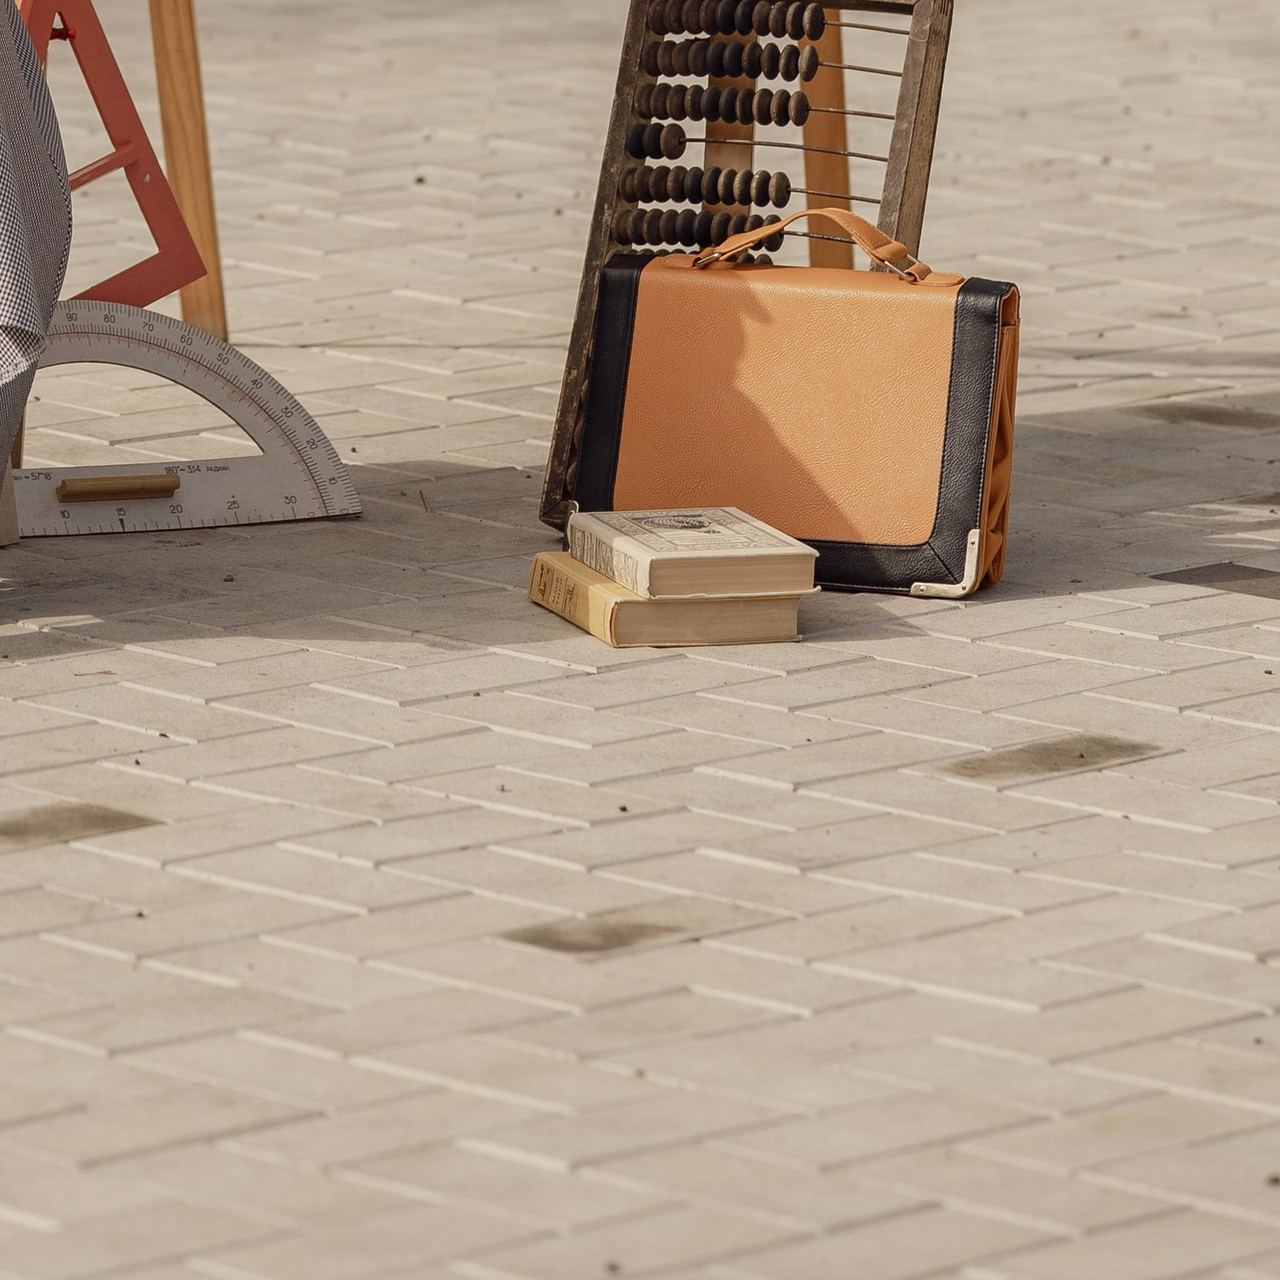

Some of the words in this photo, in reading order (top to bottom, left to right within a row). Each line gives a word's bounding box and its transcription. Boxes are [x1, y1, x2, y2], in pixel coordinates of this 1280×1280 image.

[65, 312, 78, 322] 90
[103, 313, 116, 324] 80
[142, 321, 155, 332] 70
[180, 334, 193, 347] 60
[216, 352, 230, 366] 50
[251, 378, 263, 390] 40
[280, 405, 294, 419] 30
[306, 438, 319, 450] 20
[60, 509, 70, 519] 10
[116, 507, 126, 517] 15
[169, 504, 183, 514] 20
[226, 500, 240, 510] 25
[283, 495, 297, 505] 30
